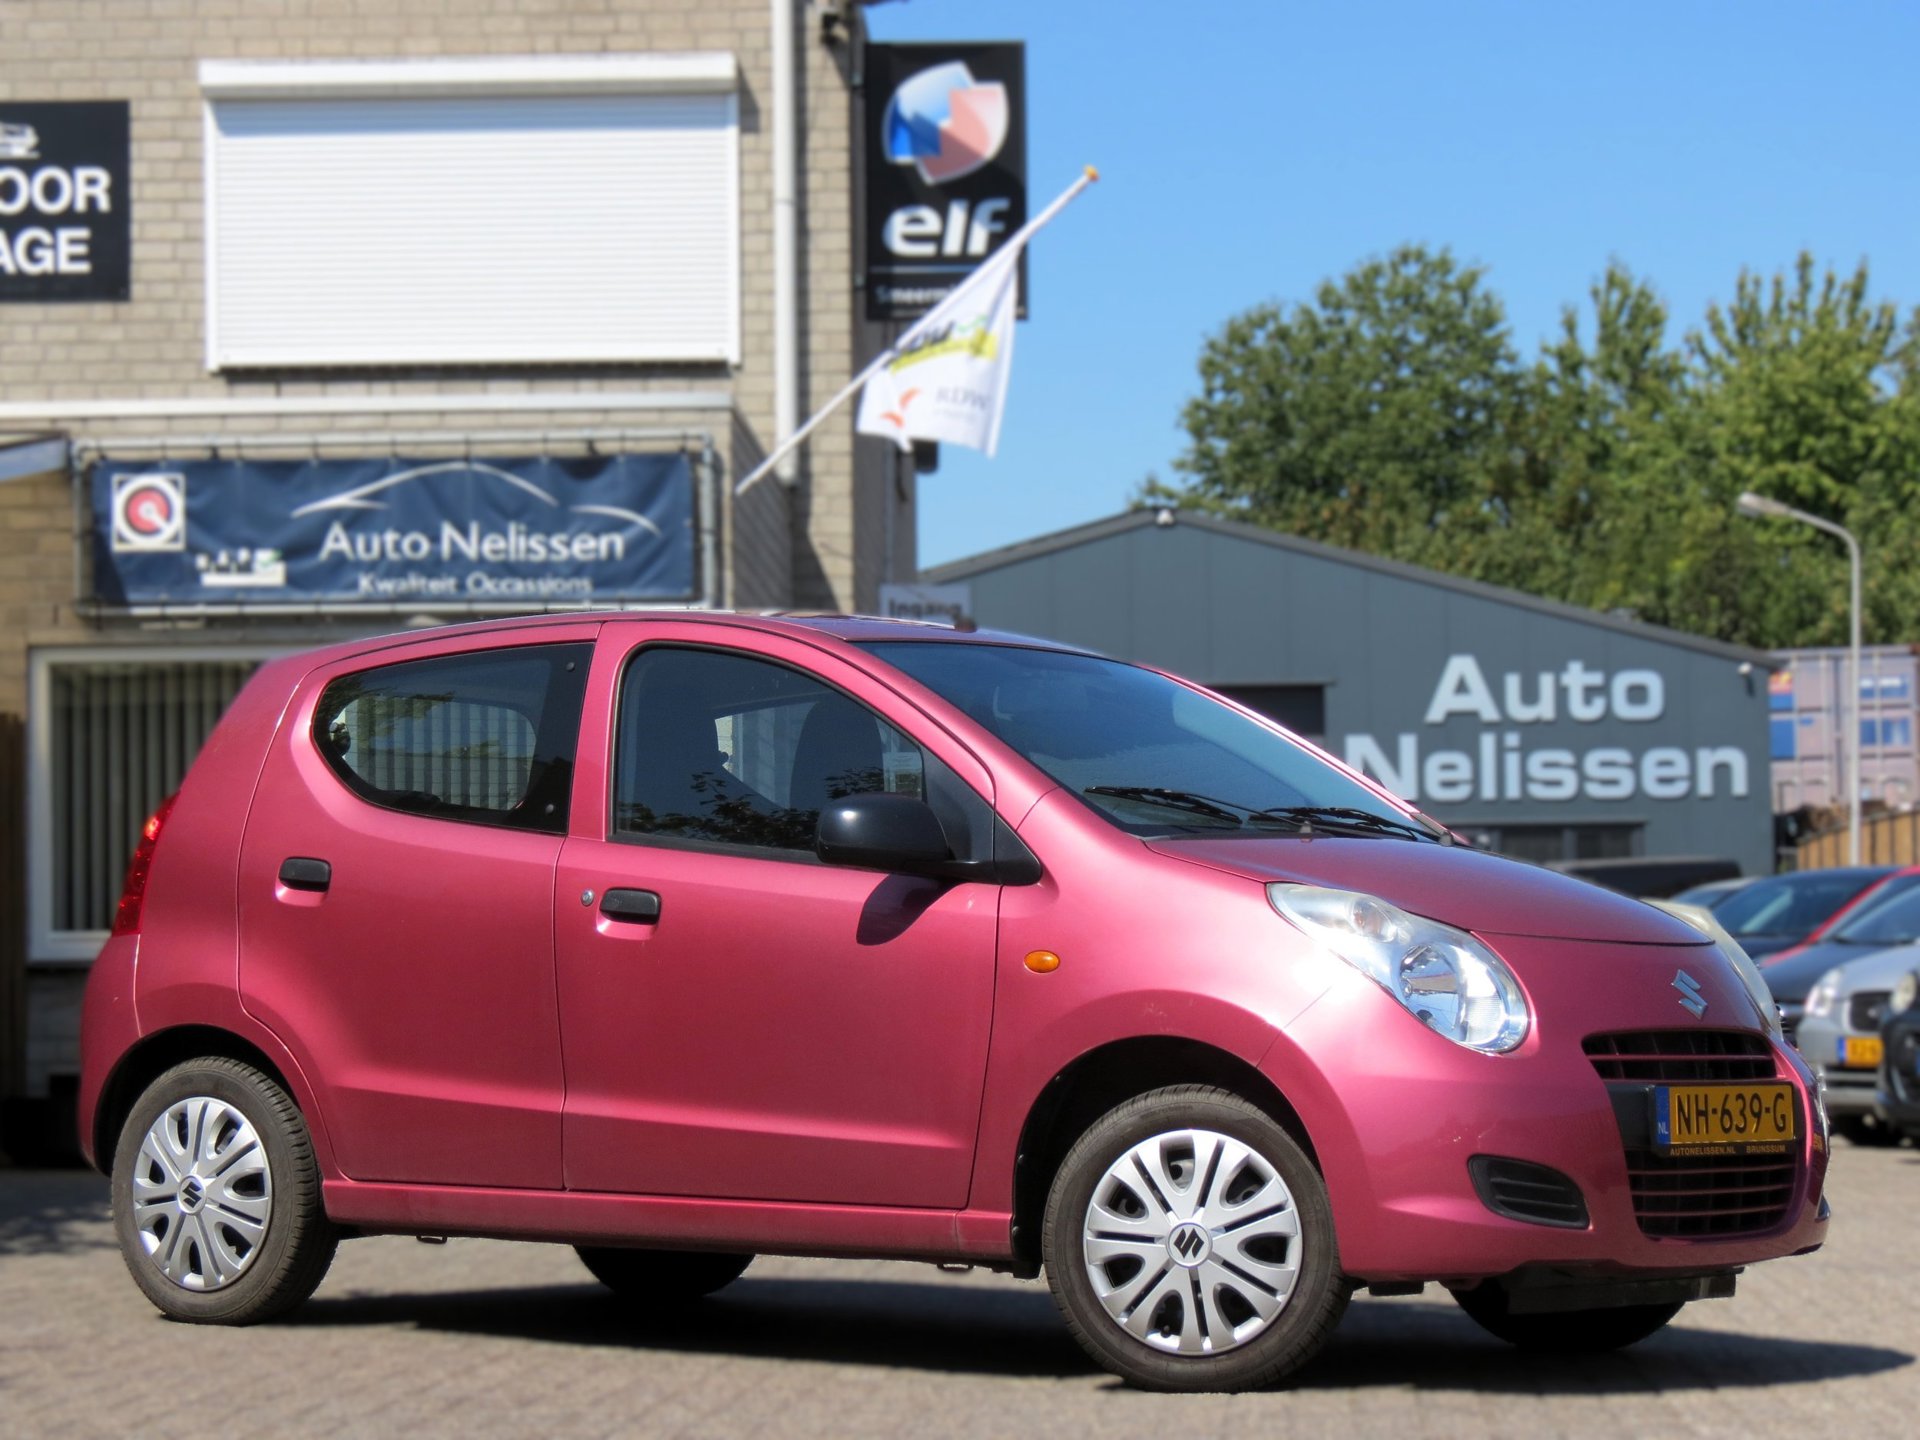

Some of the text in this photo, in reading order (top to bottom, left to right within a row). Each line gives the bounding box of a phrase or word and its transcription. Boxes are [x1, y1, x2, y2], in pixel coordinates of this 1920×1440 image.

[882, 198, 1011, 257] elf
[319, 519, 625, 561] Auto Nelissen
[358, 571, 457, 595] Kwaliteit
[1423, 654, 1665, 724] Auto
[1344, 731, 1749, 802] Nelissen
[1658, 1092, 1787, 1135] NL NH-639-G
[1669, 1144, 1786, 1157] AUTONELISSEN.NL BRUNSSUM
